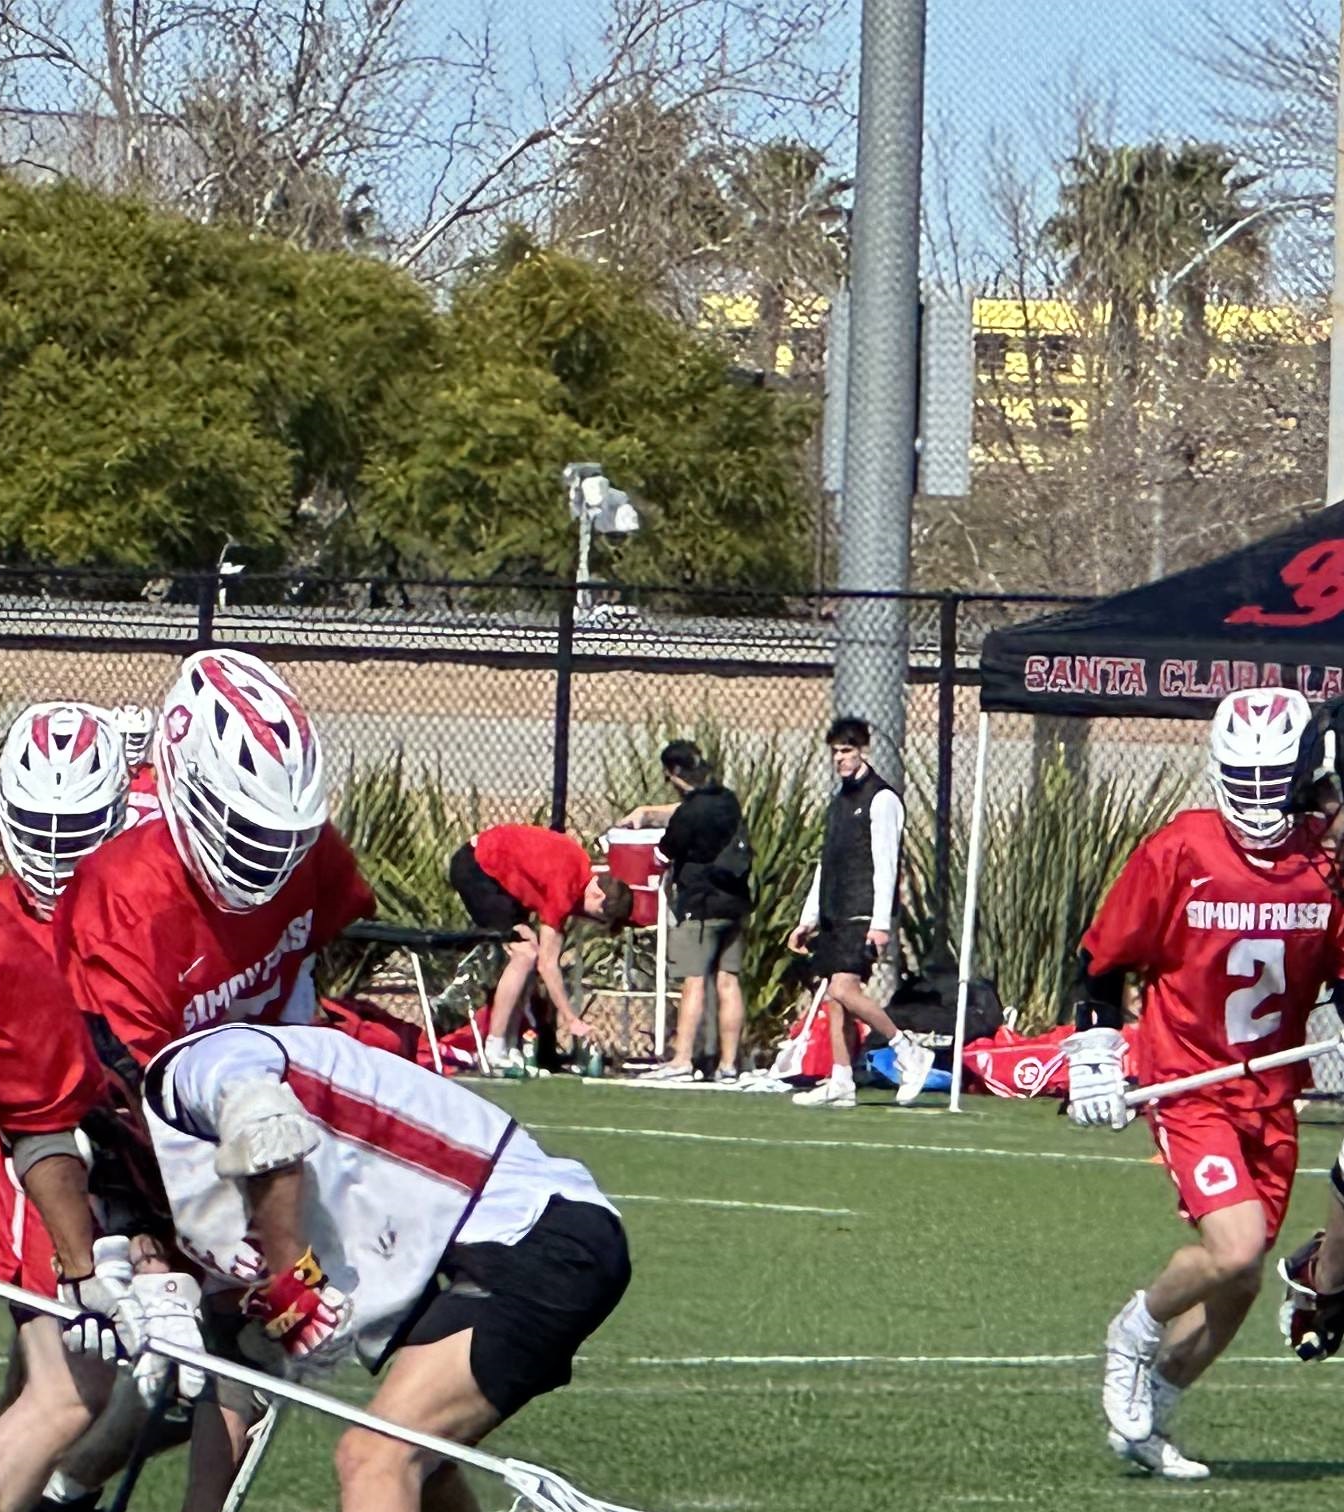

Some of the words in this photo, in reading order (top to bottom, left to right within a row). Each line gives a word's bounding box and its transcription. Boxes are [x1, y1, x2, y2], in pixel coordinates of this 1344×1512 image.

[1024, 655, 1148, 697] SANTA
[1159, 659, 1283, 698] CLARA
[1185, 900, 1256, 931] SIMON
[1258, 902, 1332, 931] FRASER
[182, 961, 261, 1033] SIMON
[1224, 938, 1287, 1047] 2
